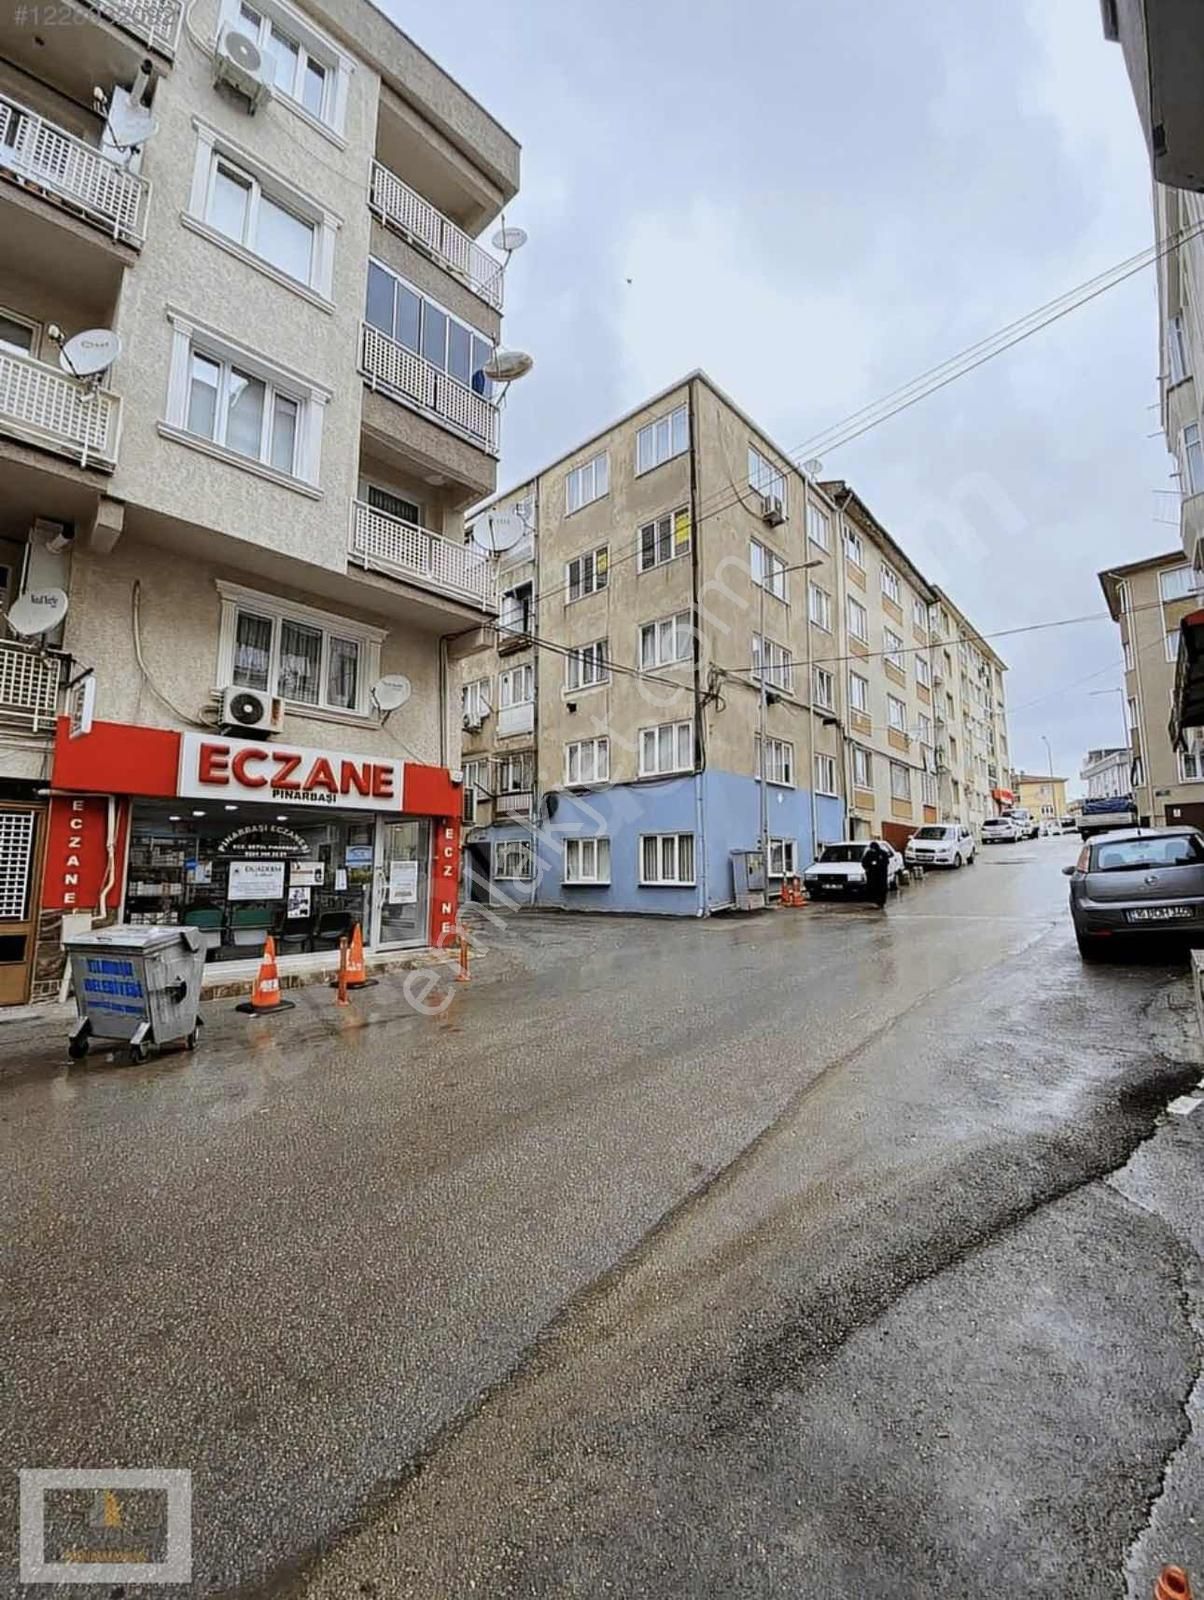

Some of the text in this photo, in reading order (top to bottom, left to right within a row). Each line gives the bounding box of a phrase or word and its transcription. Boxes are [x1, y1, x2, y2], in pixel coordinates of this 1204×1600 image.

[198, 742, 394, 798] ECZANE
[272, 789, 337, 804] PINARBAŞI
[64, 800, 85, 904] ECZANE
